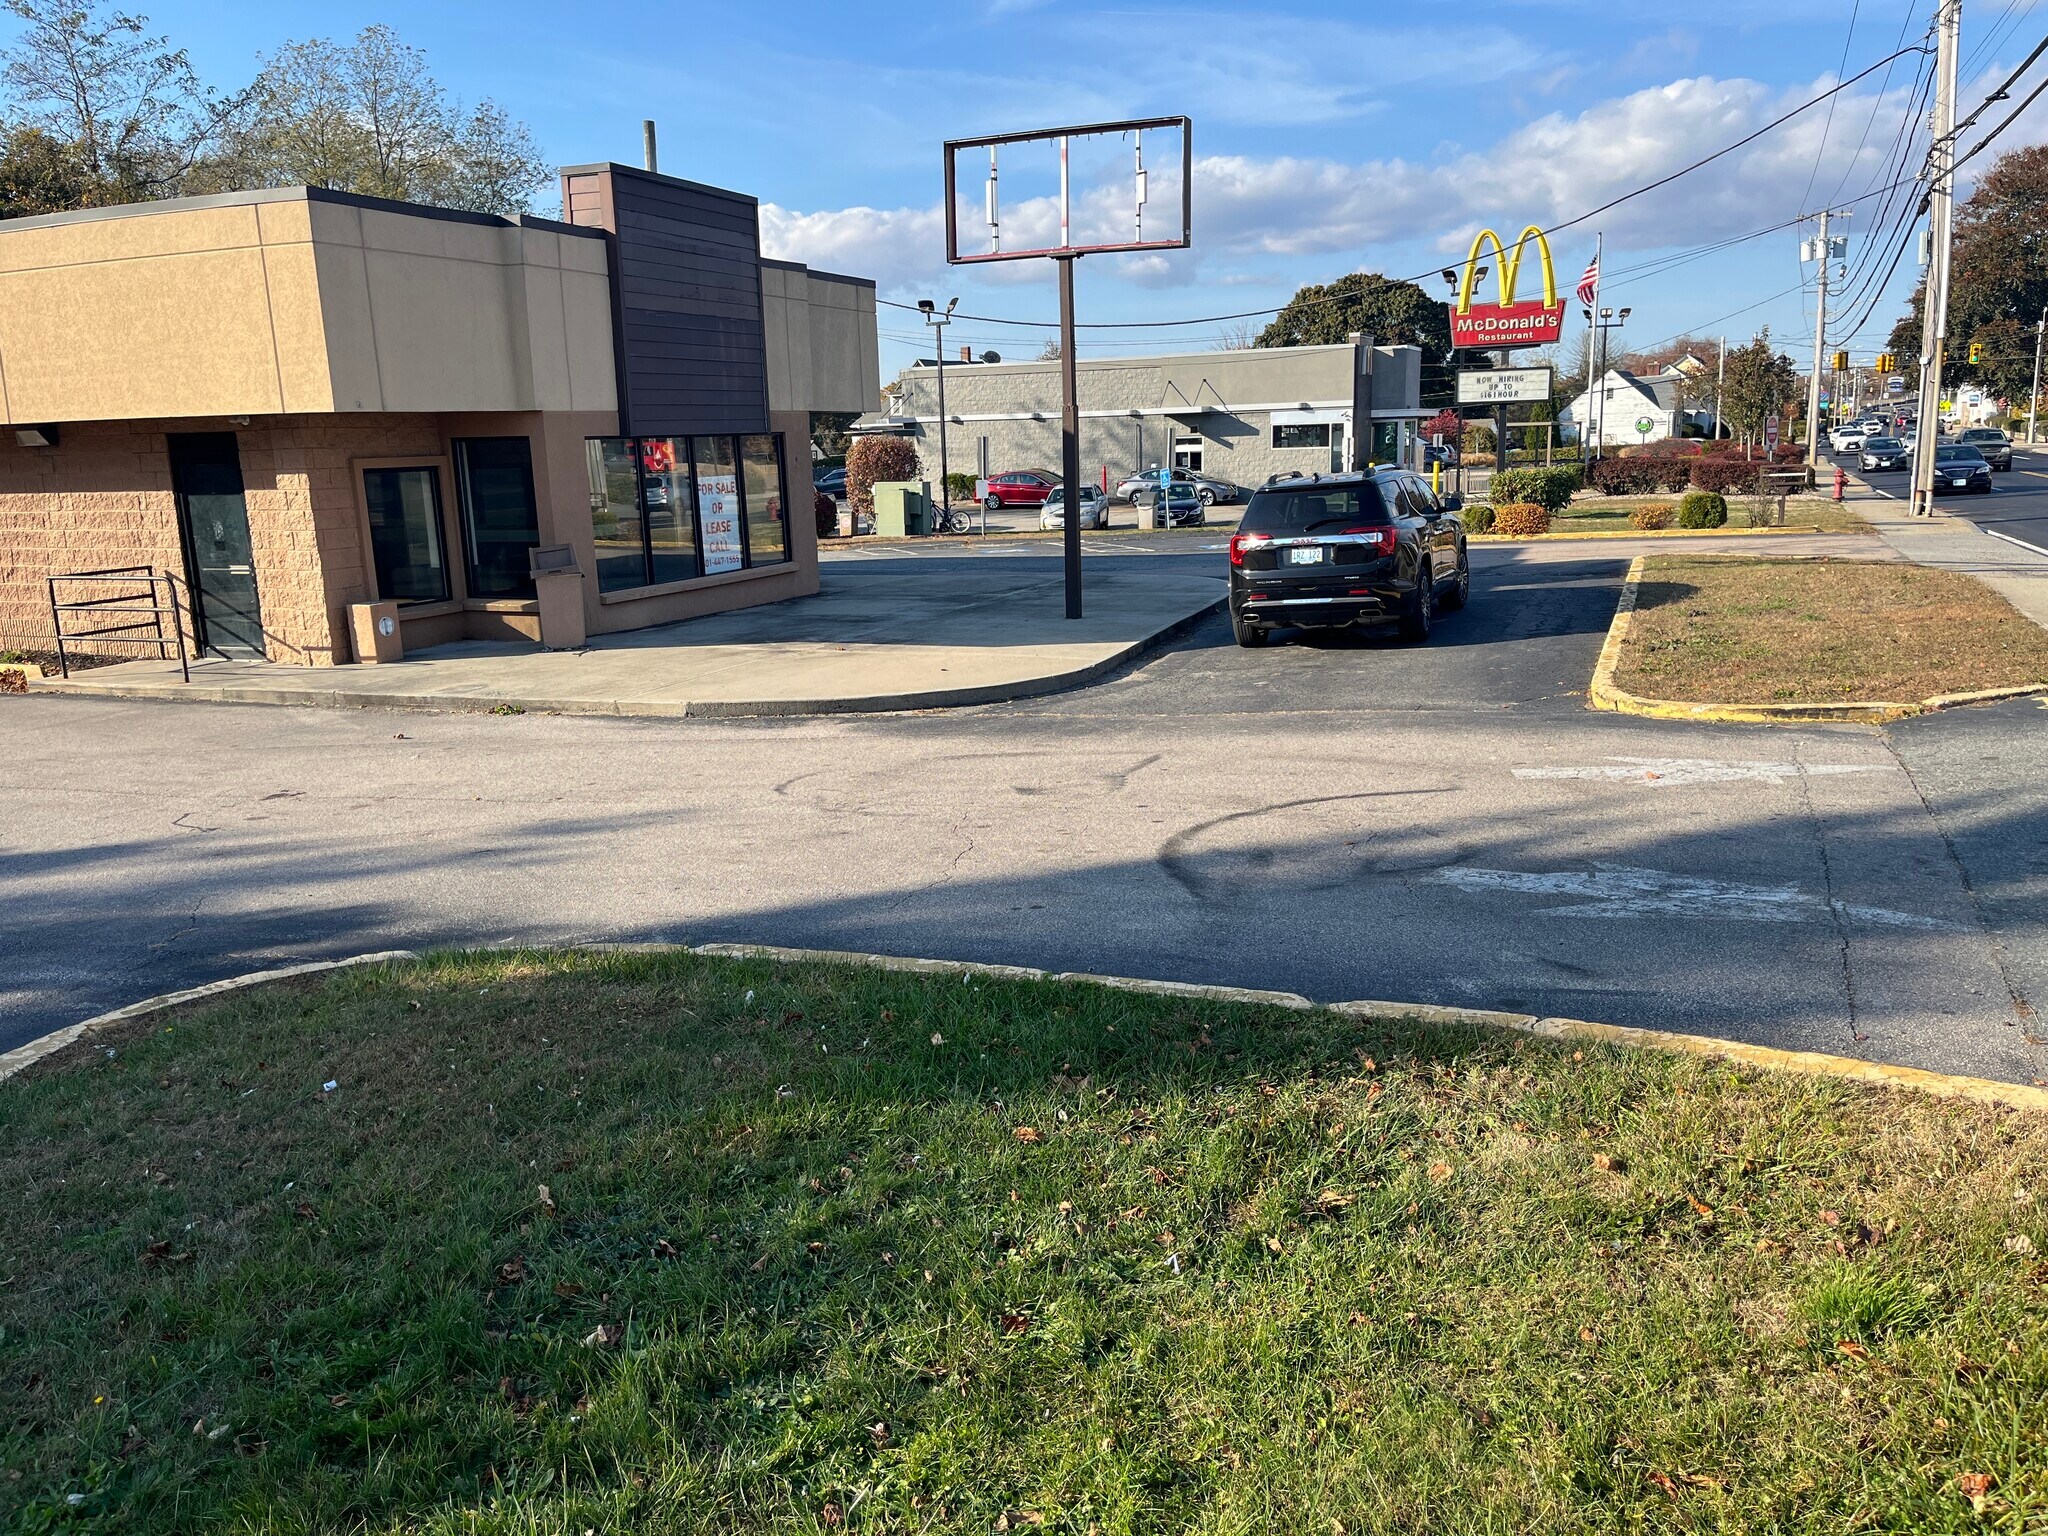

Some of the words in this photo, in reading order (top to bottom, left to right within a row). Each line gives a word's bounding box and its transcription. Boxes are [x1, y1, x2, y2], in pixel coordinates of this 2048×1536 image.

[1456, 314, 1558, 332] McDonald's
[1478, 331, 1534, 341] Restaurant
[1476, 376, 1492, 384] NOW
[1499, 375, 1524, 383] HIRING
[697, 483, 714, 496] FOR
[715, 481, 735, 495] SALE
[711, 502, 724, 514] OR
[706, 520, 731, 534] LEASE
[709, 539, 731, 553] CALL
